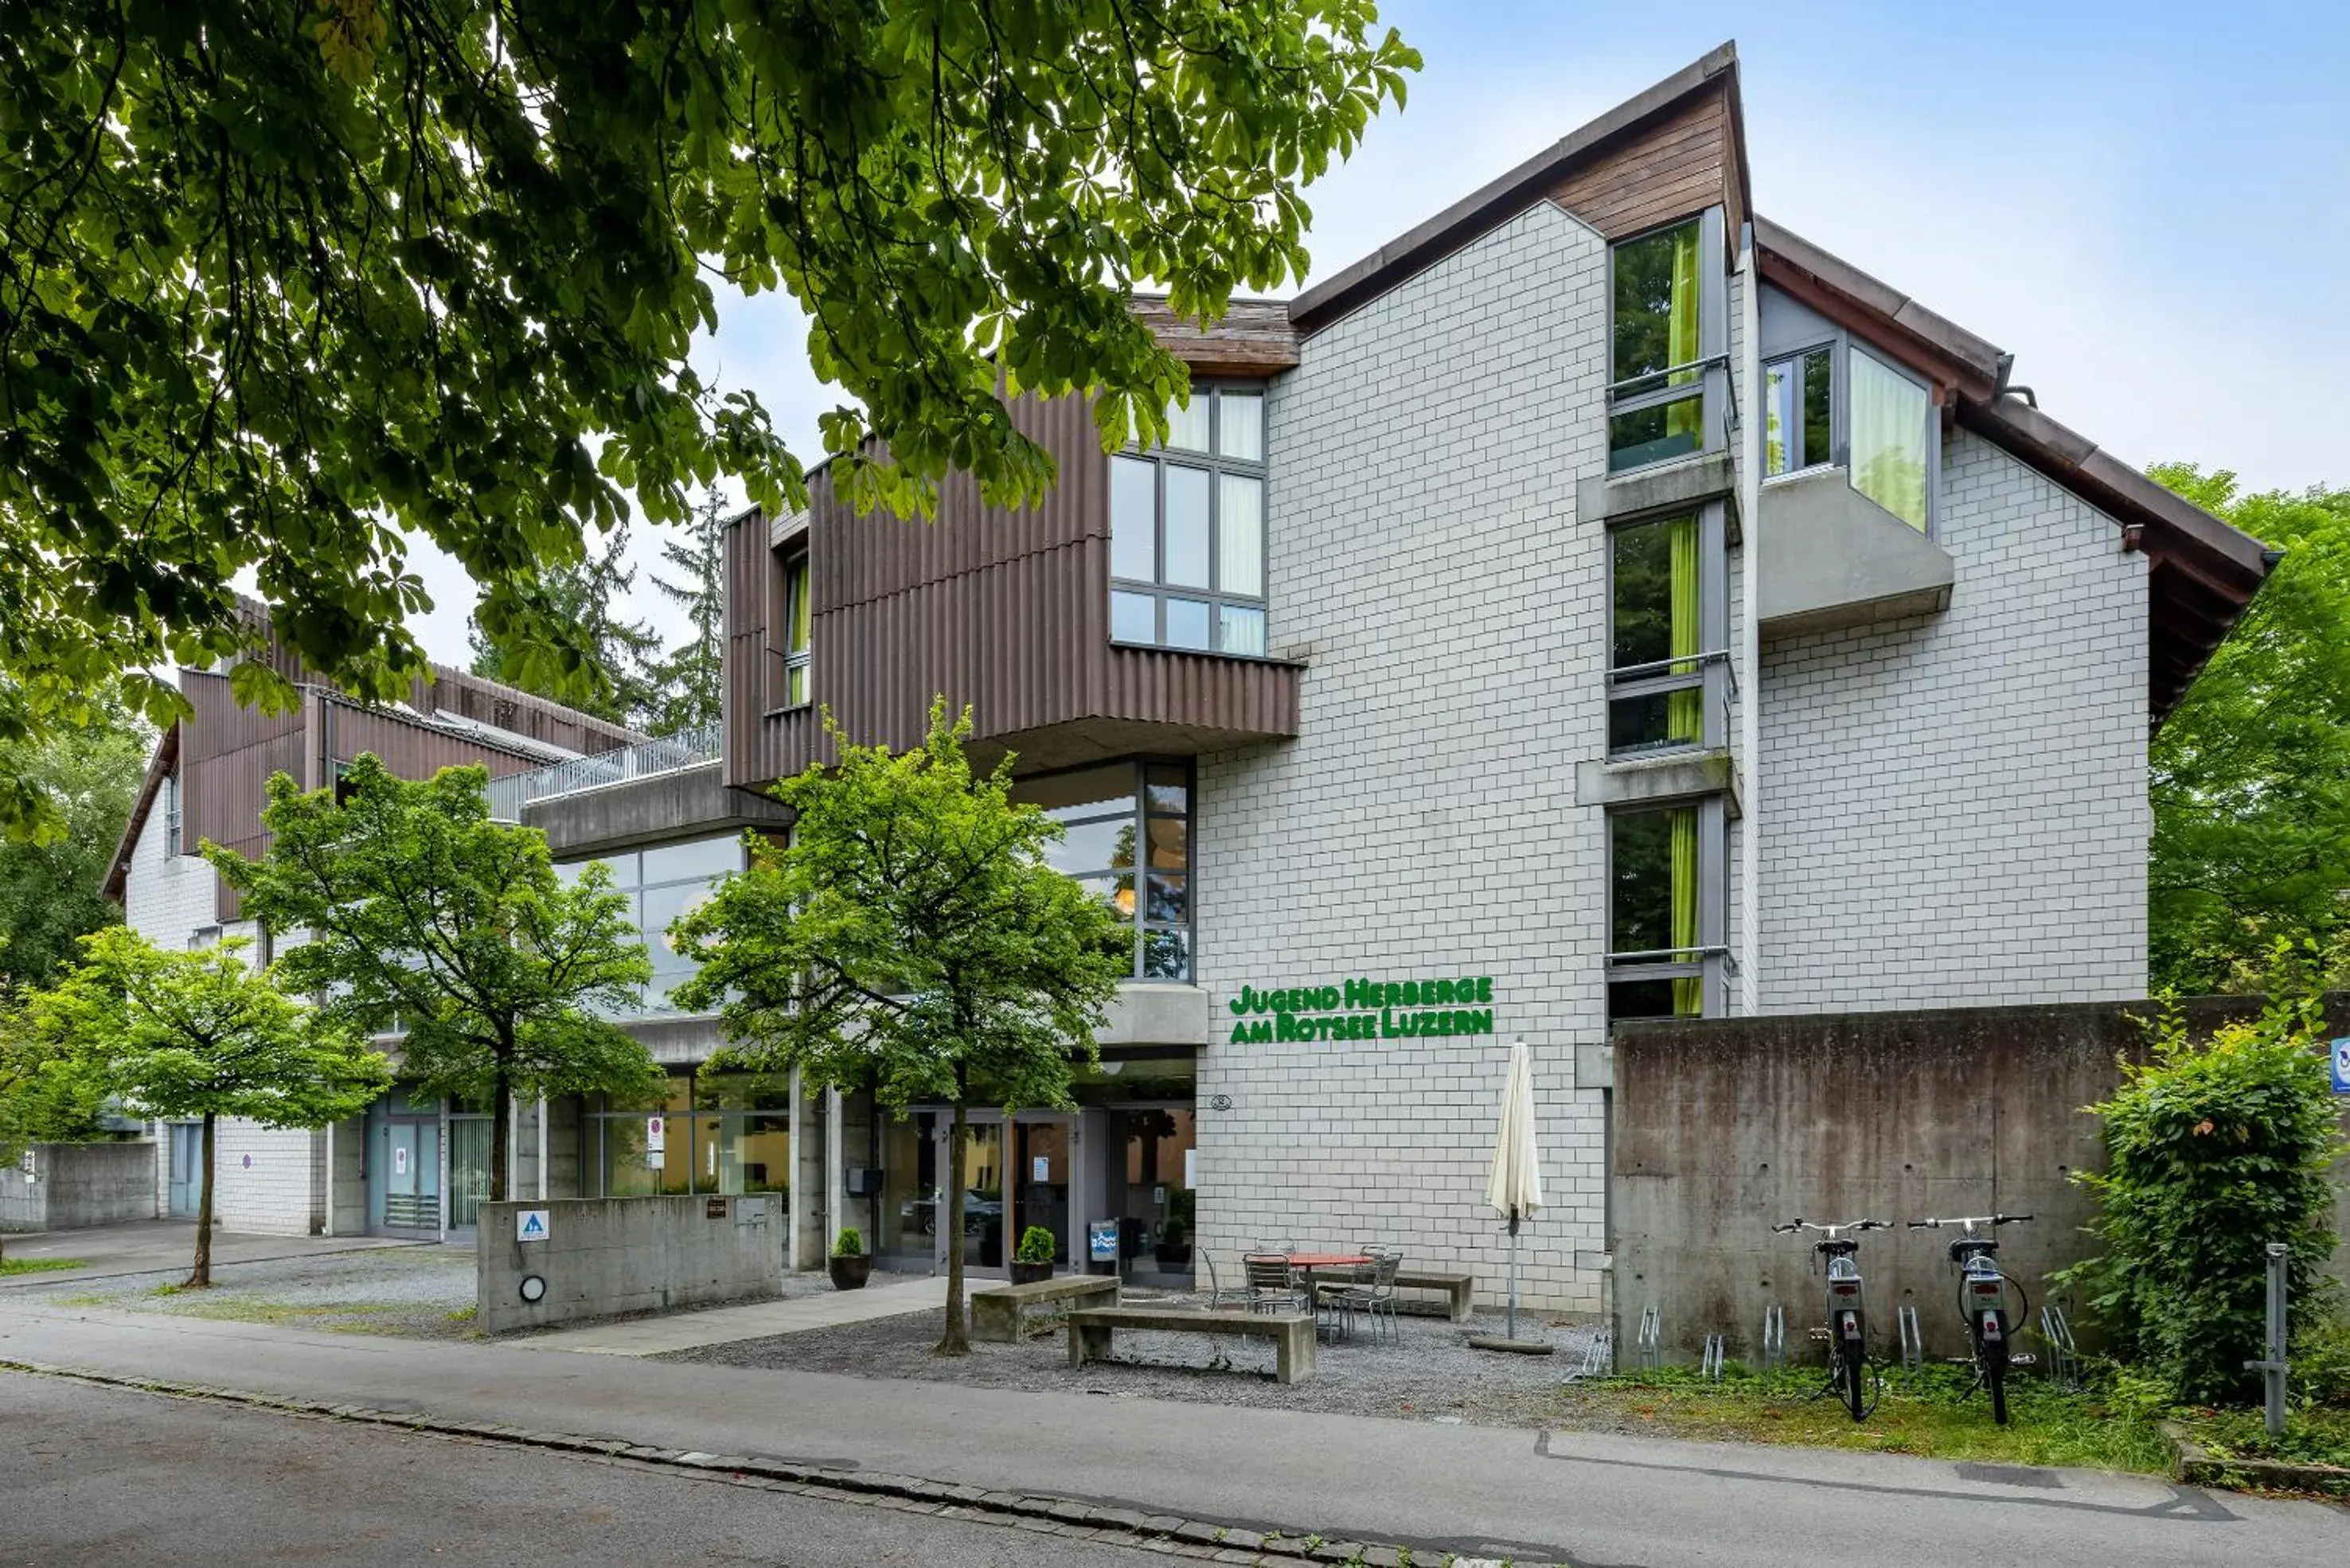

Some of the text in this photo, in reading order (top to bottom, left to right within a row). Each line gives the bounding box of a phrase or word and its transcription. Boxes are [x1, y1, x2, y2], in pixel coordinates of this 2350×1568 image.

[1230, 977, 1493, 1015] JUGEND HERBERGE
[1230, 1008, 1493, 1044] AM ROTSEE LUZERN
